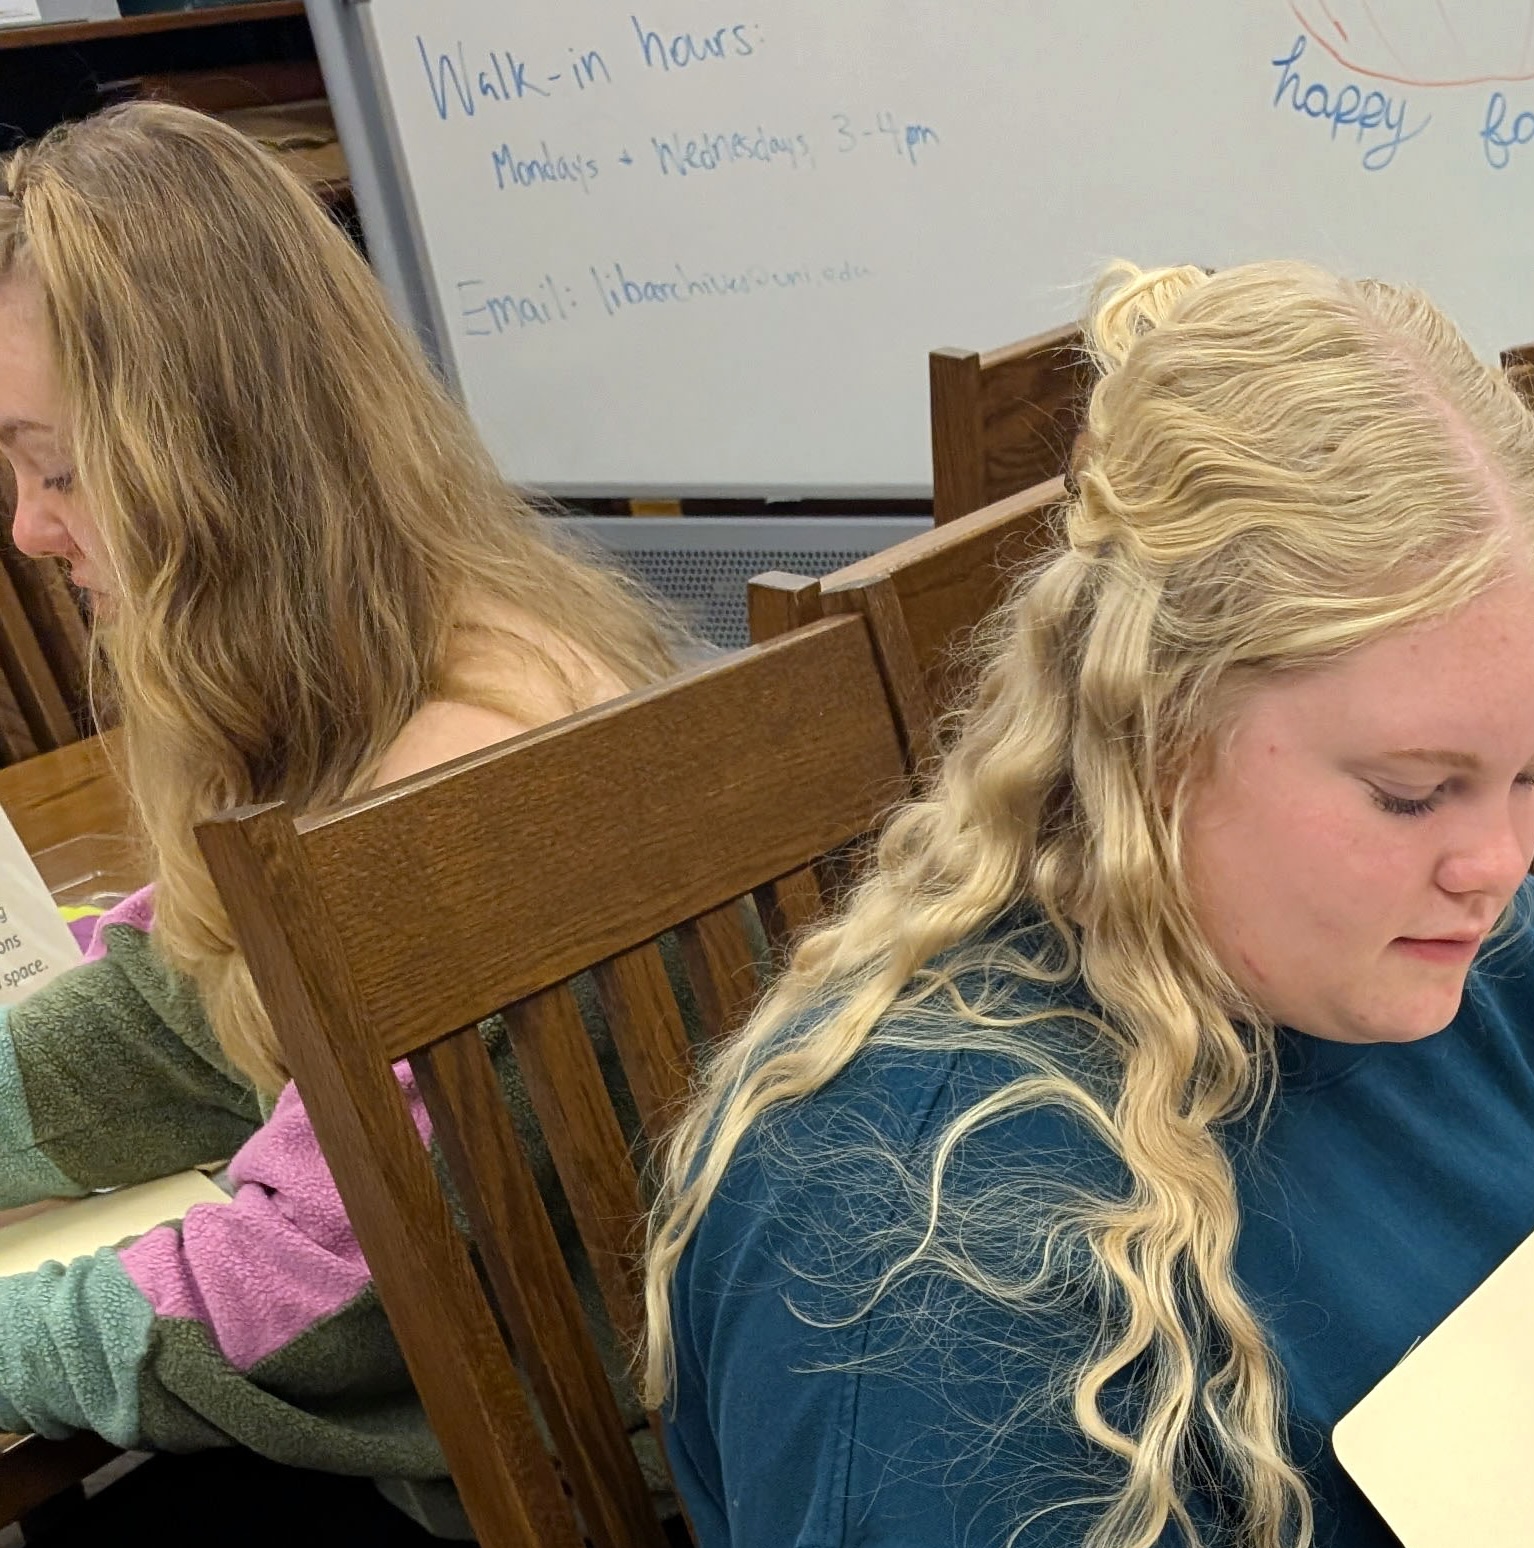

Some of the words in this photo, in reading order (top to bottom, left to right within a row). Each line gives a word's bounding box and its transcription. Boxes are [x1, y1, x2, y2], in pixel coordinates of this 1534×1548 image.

[415, 35, 612, 120] Walk-in
[630, 15, 766, 72] hours:
[1272, 35, 1431, 171] happy
[491, 140, 599, 194] Mondays
[457, 273, 578, 336] Email:
[4, 959, 49, 987] space.
